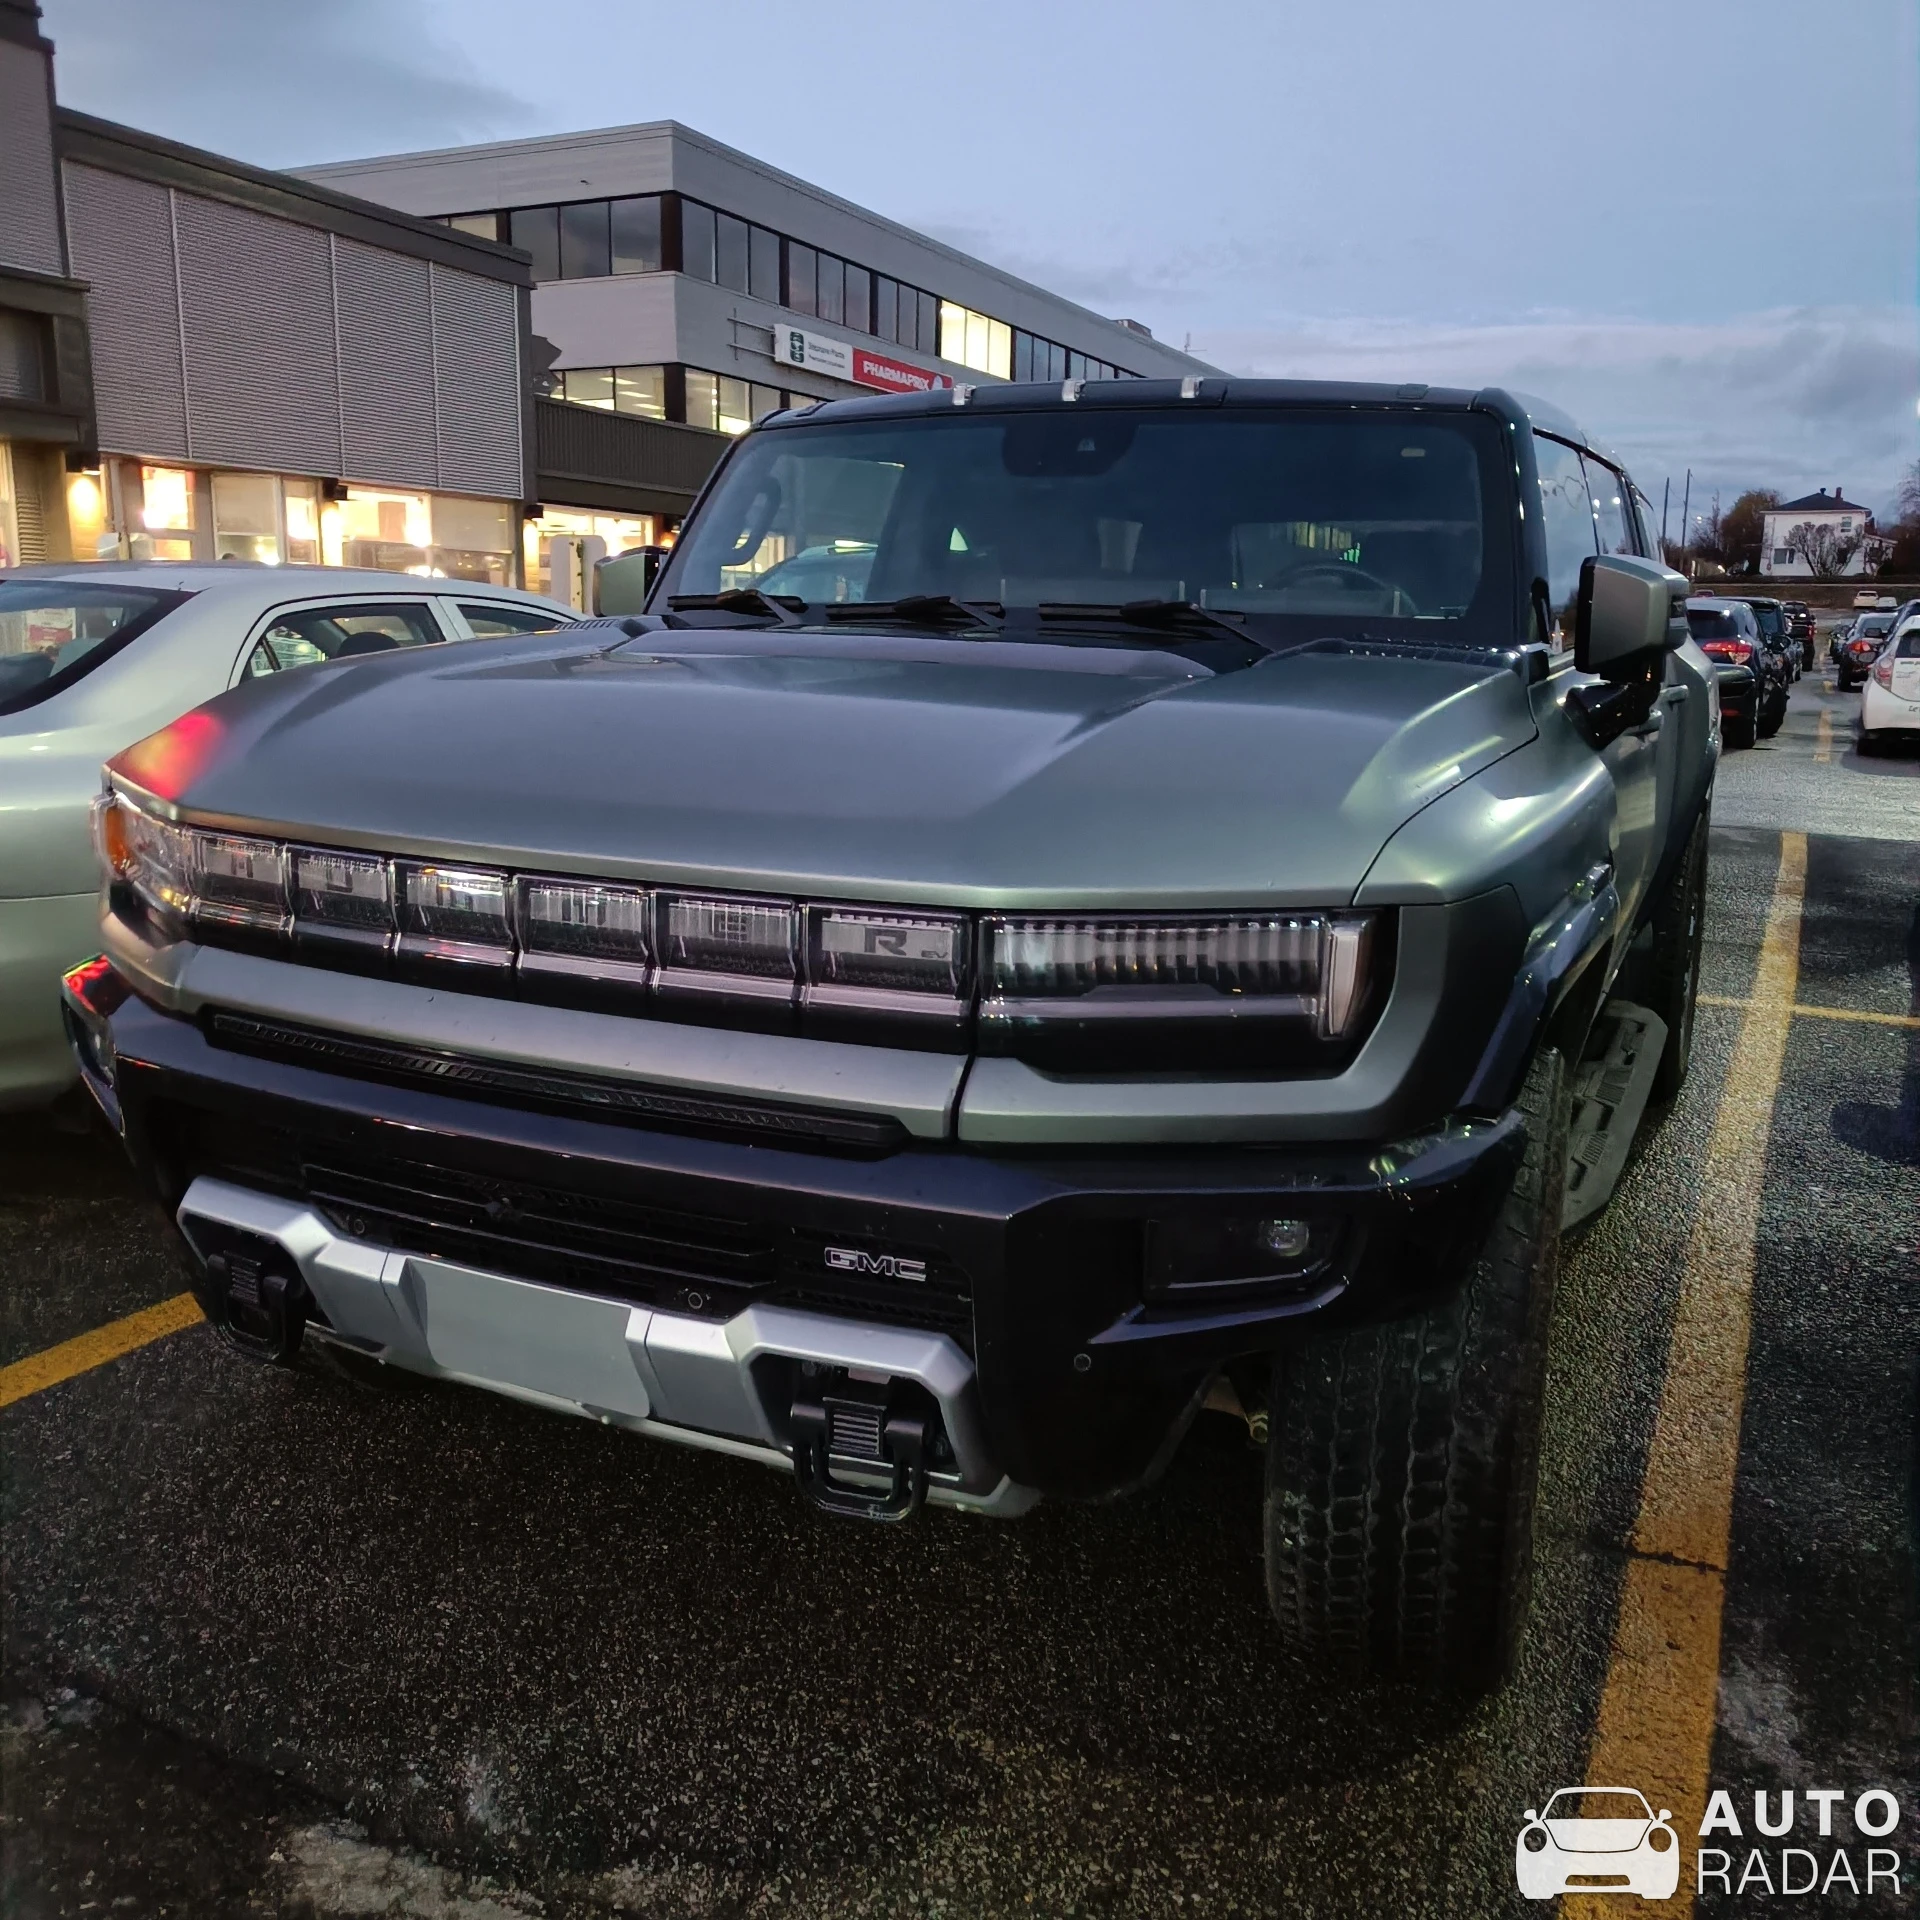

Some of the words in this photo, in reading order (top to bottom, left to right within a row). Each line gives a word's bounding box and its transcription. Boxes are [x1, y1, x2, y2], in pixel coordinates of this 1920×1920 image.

[863, 361, 930, 391] PHARMAPRIX
[921, 949, 949, 959] EV
[824, 1246, 927, 1282] GMC
